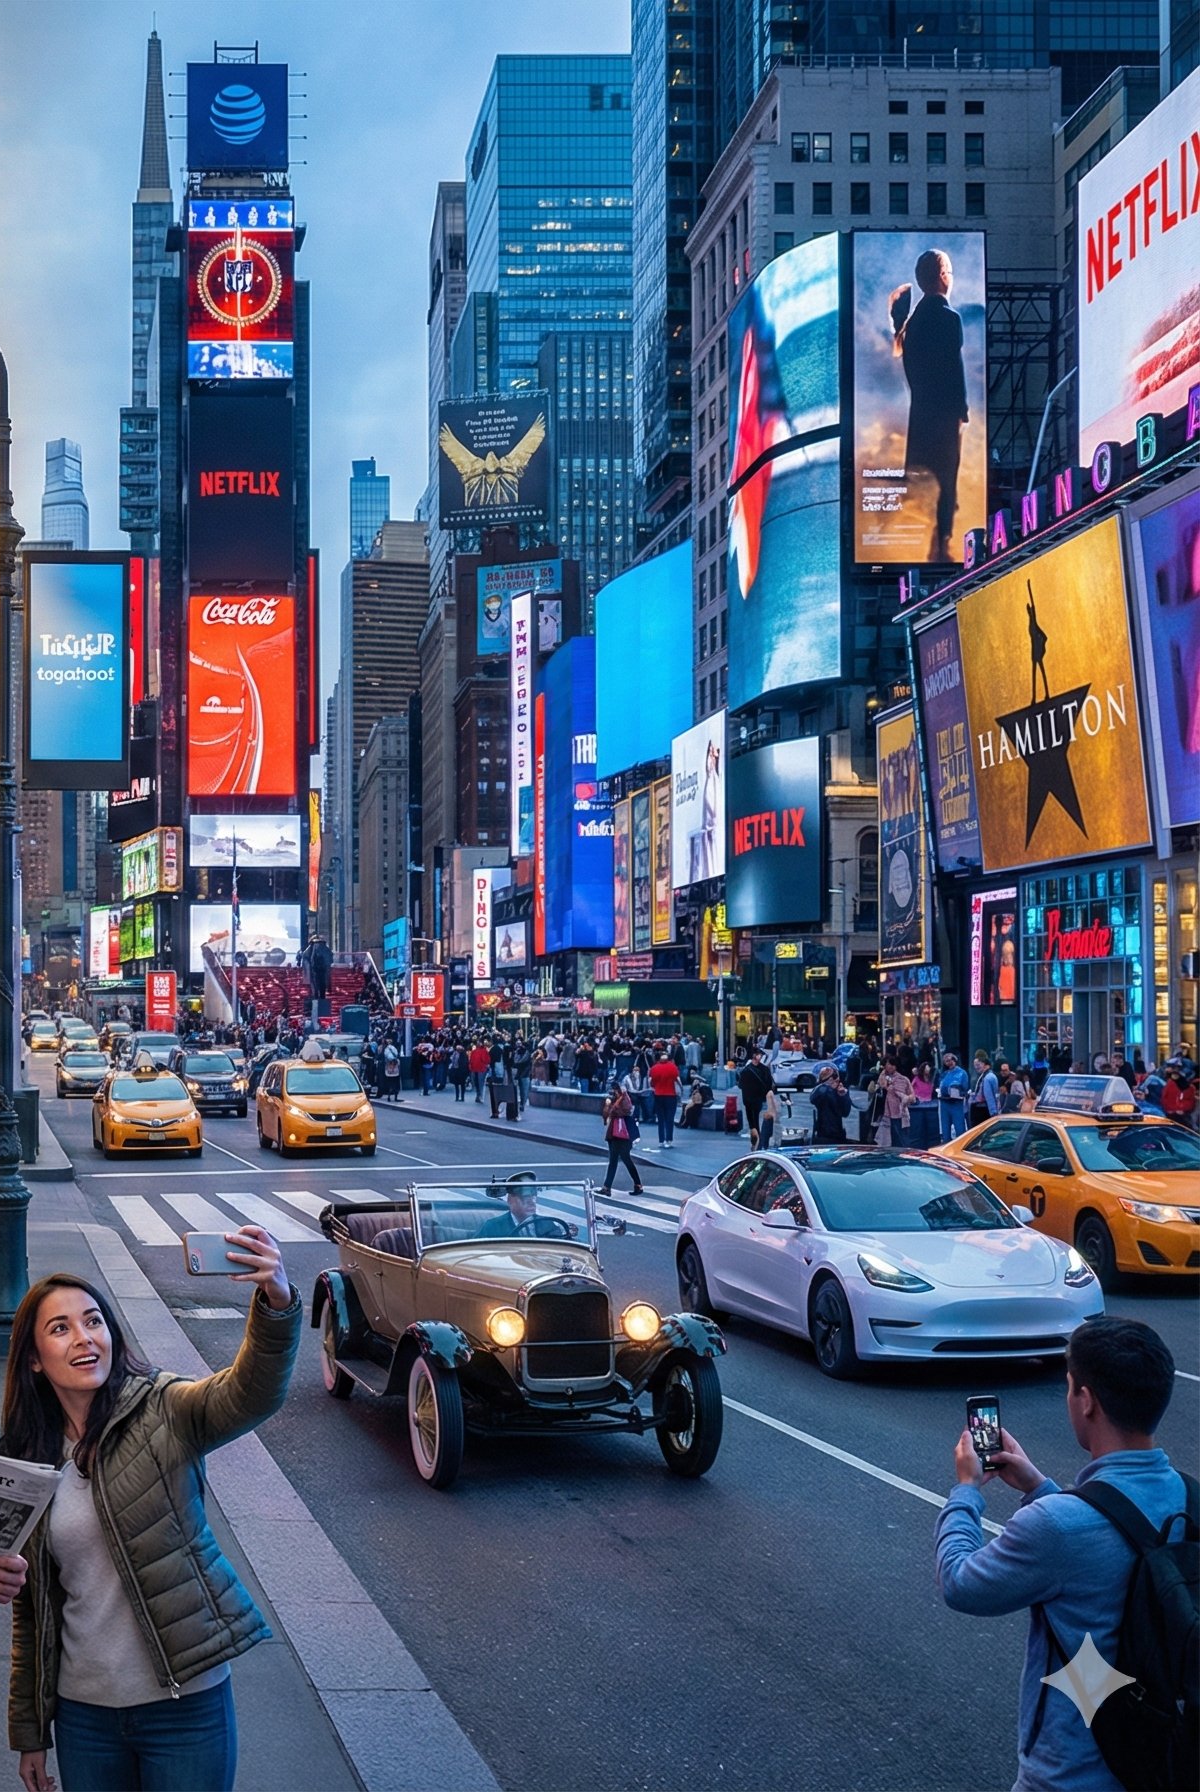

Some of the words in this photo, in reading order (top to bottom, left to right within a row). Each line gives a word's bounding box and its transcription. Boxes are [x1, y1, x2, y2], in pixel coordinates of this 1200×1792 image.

[200, 471, 280, 497] NETFLIX
[978, 684, 1127, 770] HAMILTON
[735, 806, 806, 856] NETFLIX
